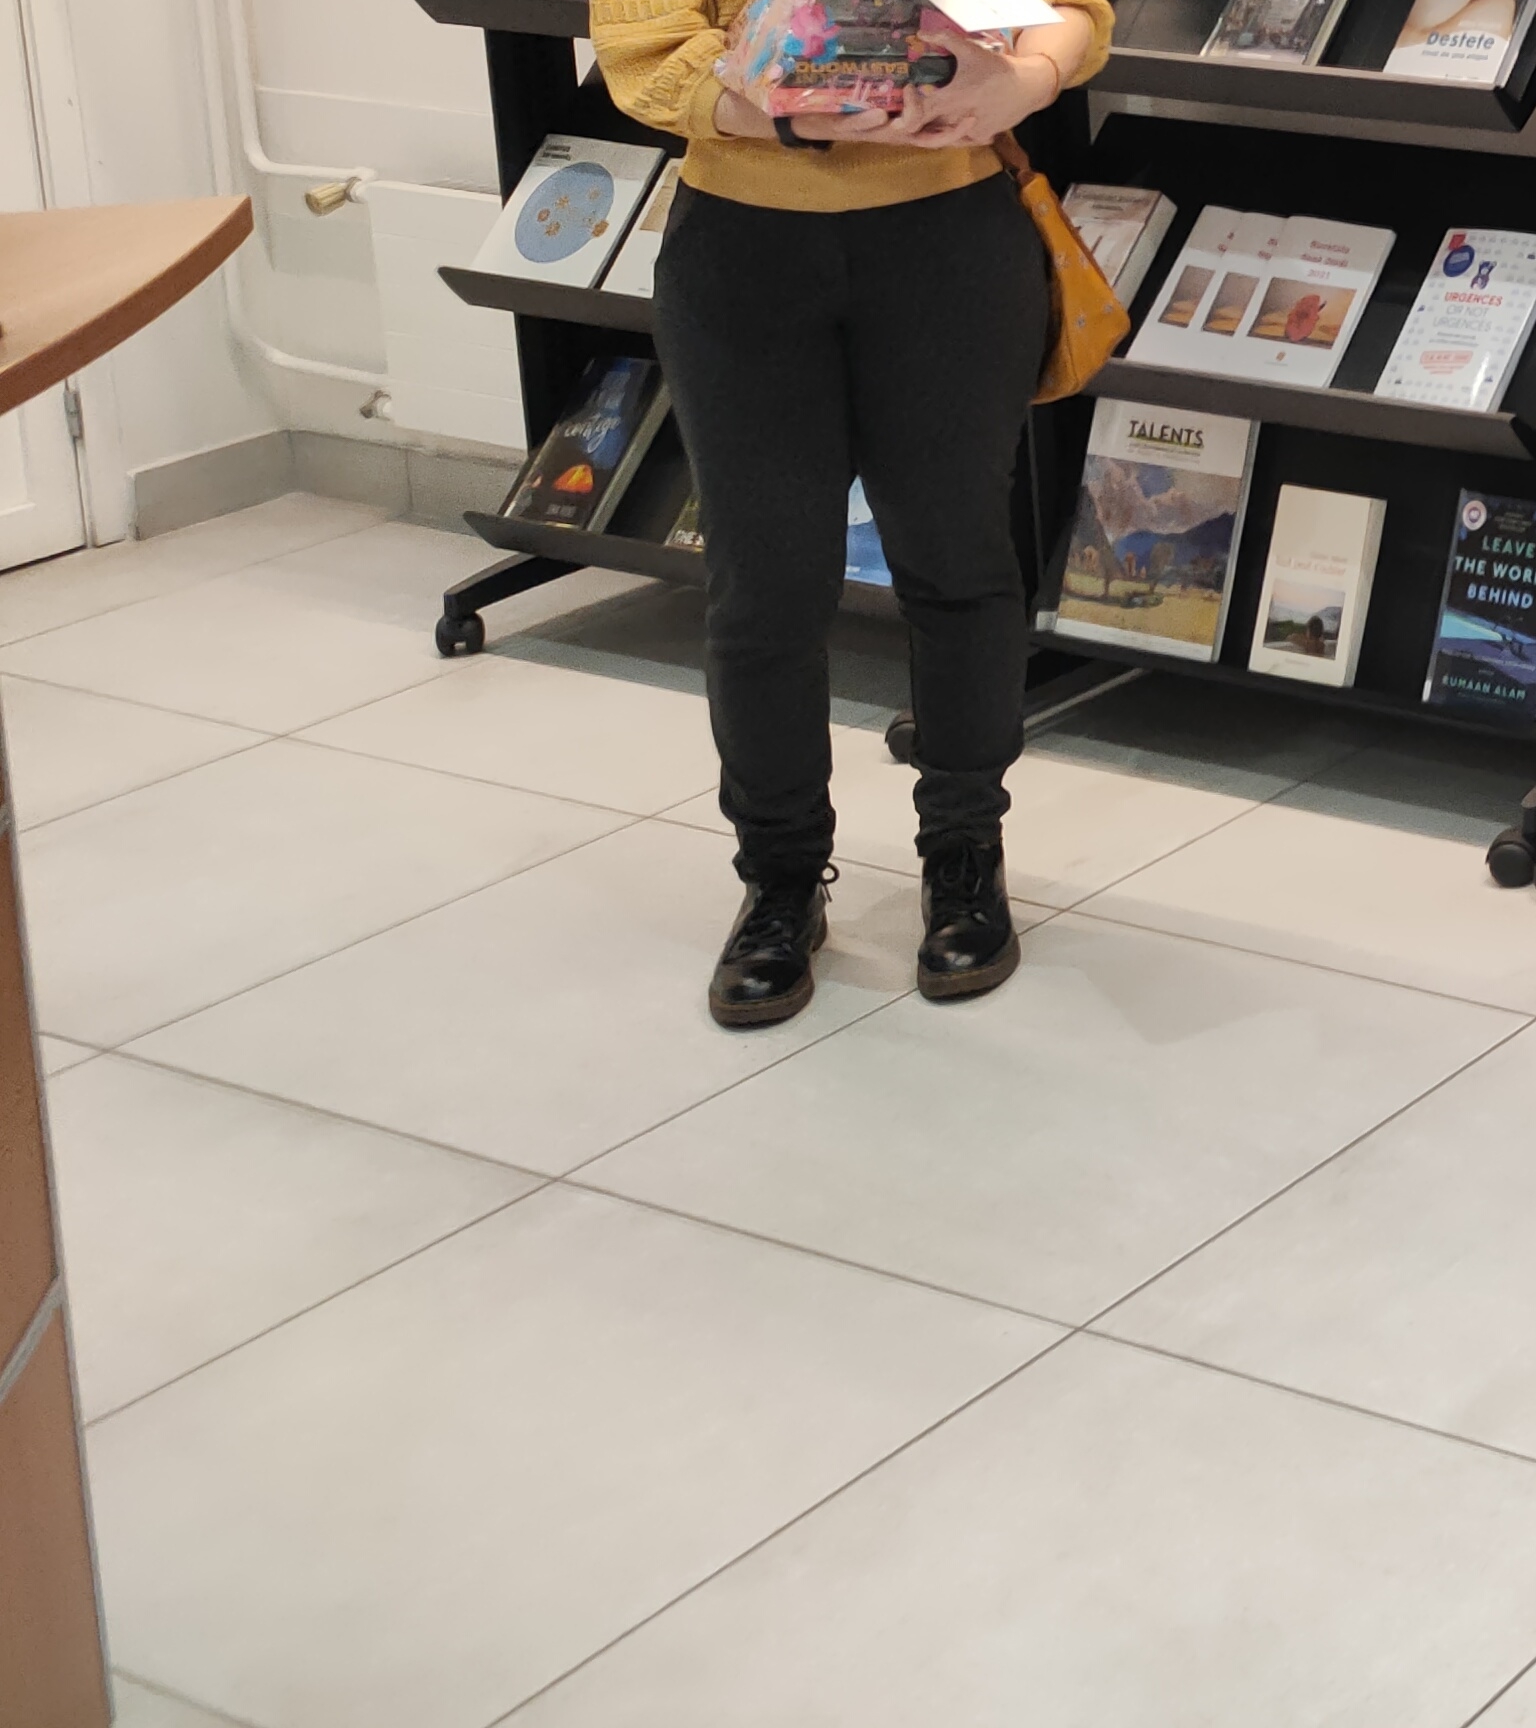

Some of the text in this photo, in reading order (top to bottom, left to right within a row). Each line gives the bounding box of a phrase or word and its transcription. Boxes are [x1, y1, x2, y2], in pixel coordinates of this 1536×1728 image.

[1444, 292, 1503, 306] URGENCES
[1433, 316, 1491, 332] URGENCES
[1128, 420, 1204, 447] TALENTS
[1481, 534, 1536, 559] LEAVE
[1455, 556, 1486, 576] THE
[1467, 583, 1534, 609] BEHIND
[1441, 675, 1526, 701] RUMAAN ALAM
